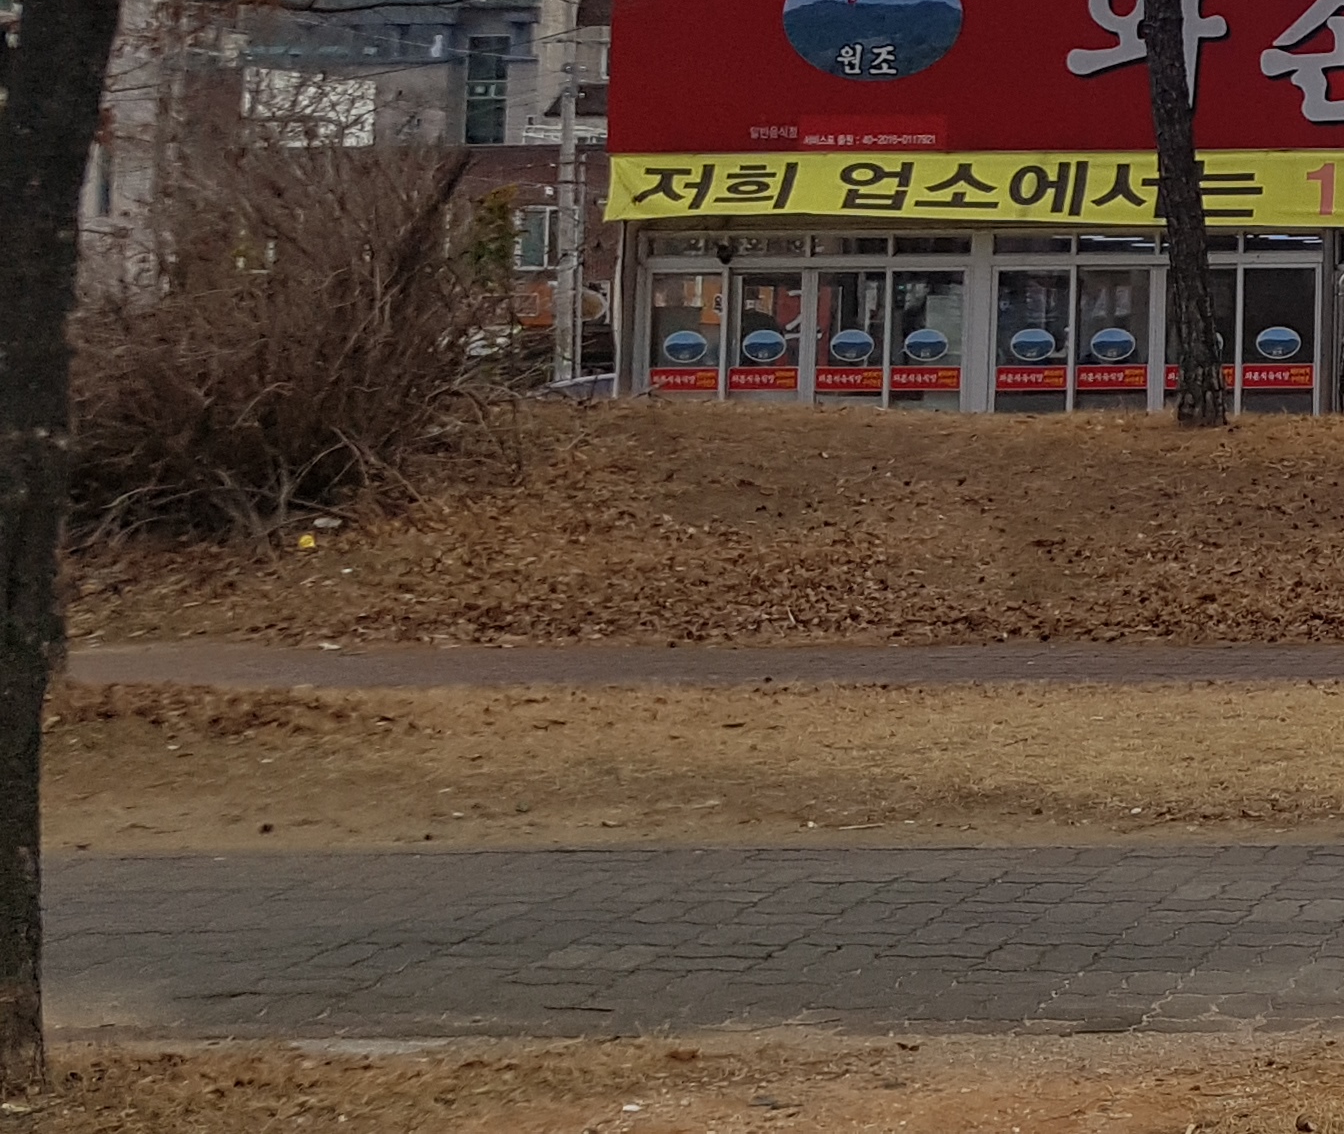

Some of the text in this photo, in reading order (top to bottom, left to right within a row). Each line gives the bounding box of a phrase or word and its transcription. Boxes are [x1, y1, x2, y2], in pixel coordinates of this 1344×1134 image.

[836, 43, 898, 75] 원조
[632, 161, 799, 210] 저희
[839, 160, 1264, 218] 업소에서는
